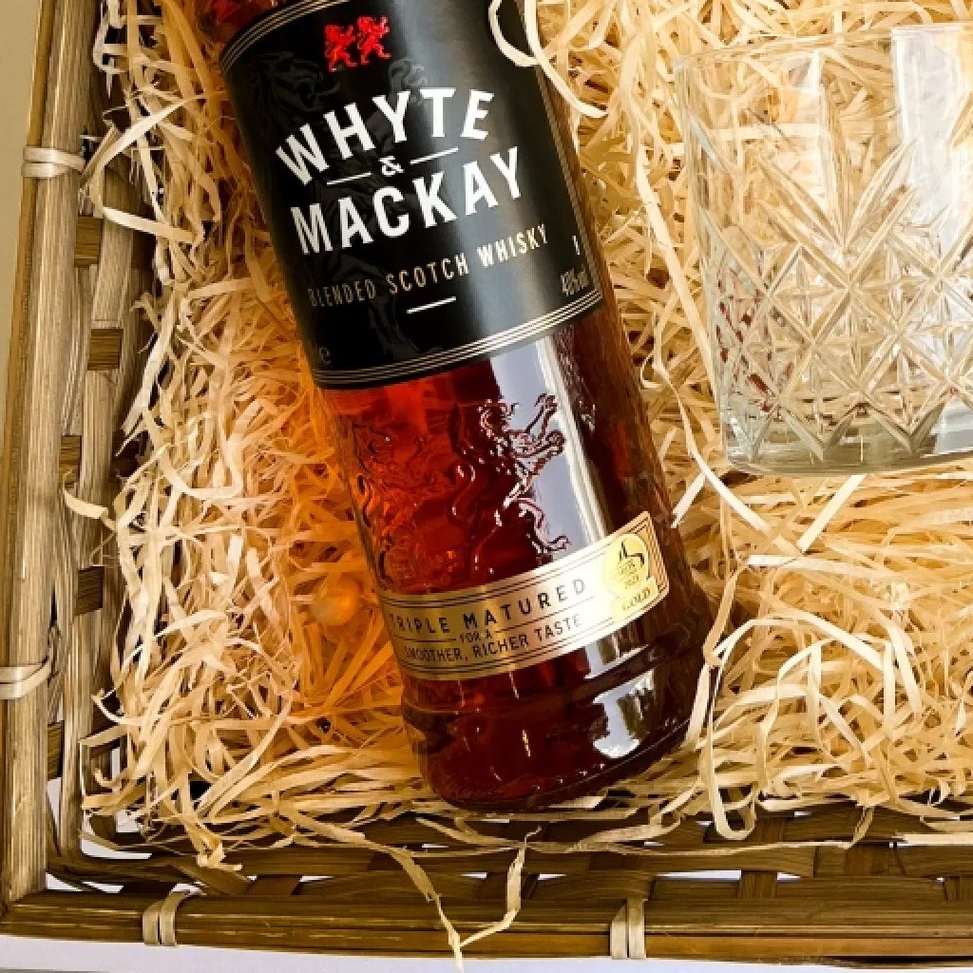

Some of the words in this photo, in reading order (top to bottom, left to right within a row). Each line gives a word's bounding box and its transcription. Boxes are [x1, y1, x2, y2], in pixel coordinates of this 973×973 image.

[275, 87, 495, 186] WHYTE
[379, 155, 404, 178] &
[290, 145, 522, 257] MACKAY
[308, 277, 378, 308] BLENDED
[387, 253, 470, 295] SCOTCH
[477, 223, 549, 268] WHISKY
[389, 613, 451, 634] TRIPLE
[462, 578, 587, 630] MATURED
[460, 631, 481, 645] FOR
[484, 628, 494, 640] A
[472, 630, 530, 659] RICHER
[536, 613, 582, 640] TASTE
